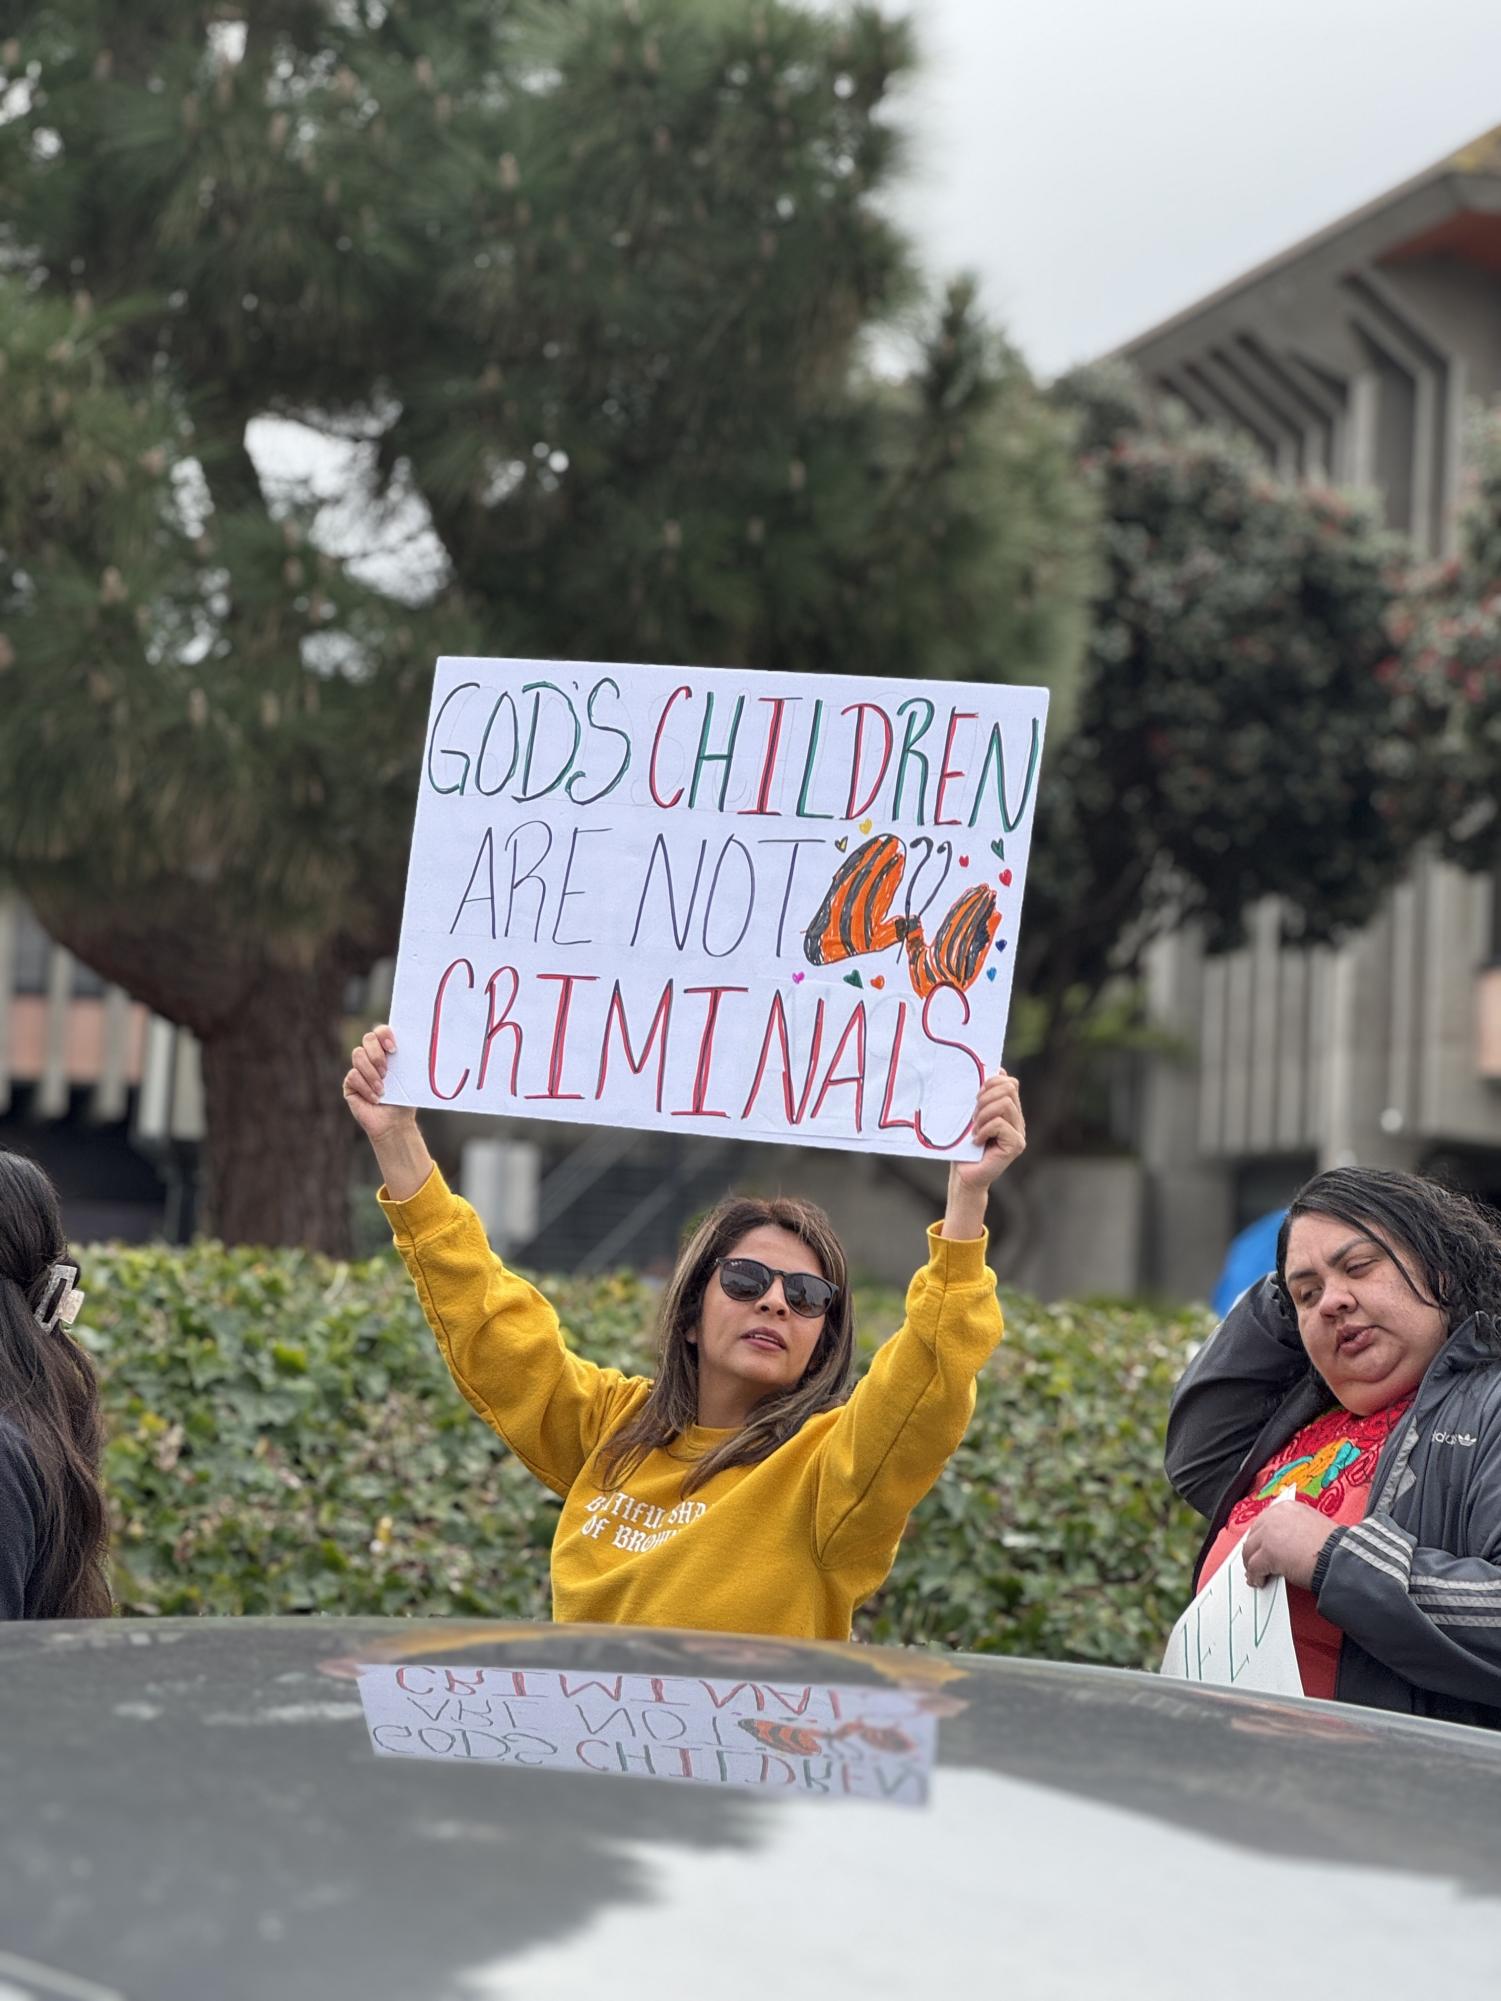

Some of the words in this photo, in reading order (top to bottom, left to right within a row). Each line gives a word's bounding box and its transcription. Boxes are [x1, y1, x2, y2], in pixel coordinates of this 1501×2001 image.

[427, 677, 632, 806] GOD'S
[648, 685, 1040, 833] CHILDREN
[449, 819, 613, 944] ARE
[630, 832, 827, 957] NOT
[428, 957, 986, 1150] CRIMINALS
[582, 1515, 609, 1539] OF
